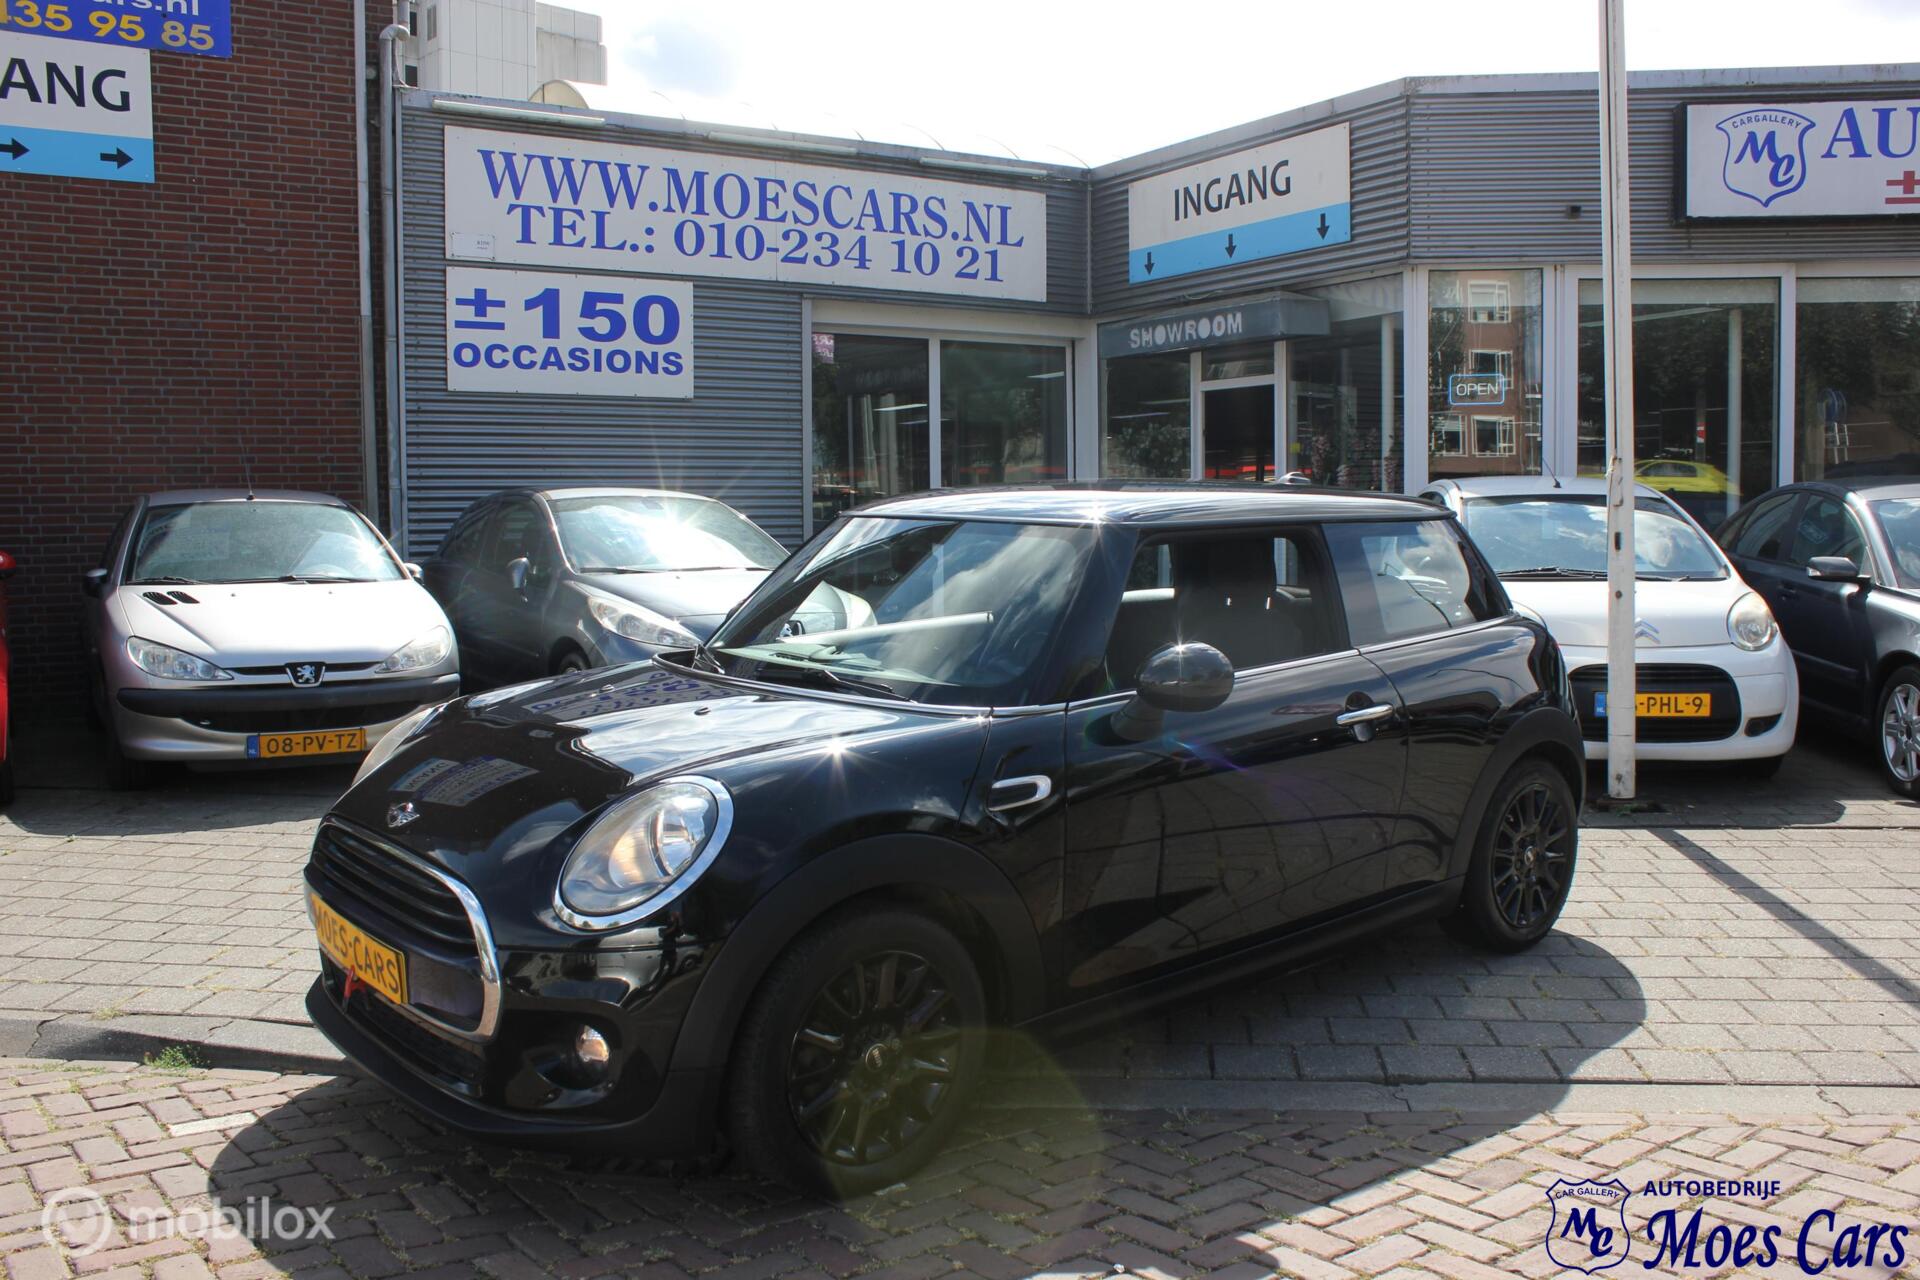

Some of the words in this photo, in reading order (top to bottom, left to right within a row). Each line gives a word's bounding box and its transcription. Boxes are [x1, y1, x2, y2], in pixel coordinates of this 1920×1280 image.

[93, 0, 199, 16] s.nl
[88, 10, 145, 42] 95
[161, 20, 215, 50] 85
[0, 57, 131, 112] ANG
[1821, 106, 1920, 158] AU
[477, 149, 1024, 248] WWW.MOESCARS.NL
[1173, 159, 1292, 222] INGANG
[506, 202, 655, 253] TEL.:
[673, 218, 870, 270] 010-234
[891, 239, 941, 275] 10
[954, 246, 1003, 282] 21
[1129, 311, 1243, 349] SHOWROOM
[451, 341, 684, 377] OCCASIONS
[1455, 381, 1499, 397] OPEN
[1635, 696, 1704, 714] -PHL-9
[266, 732, 357, 755] 08-PV-TZ
[313, 903, 400, 995] MOES-CARS
